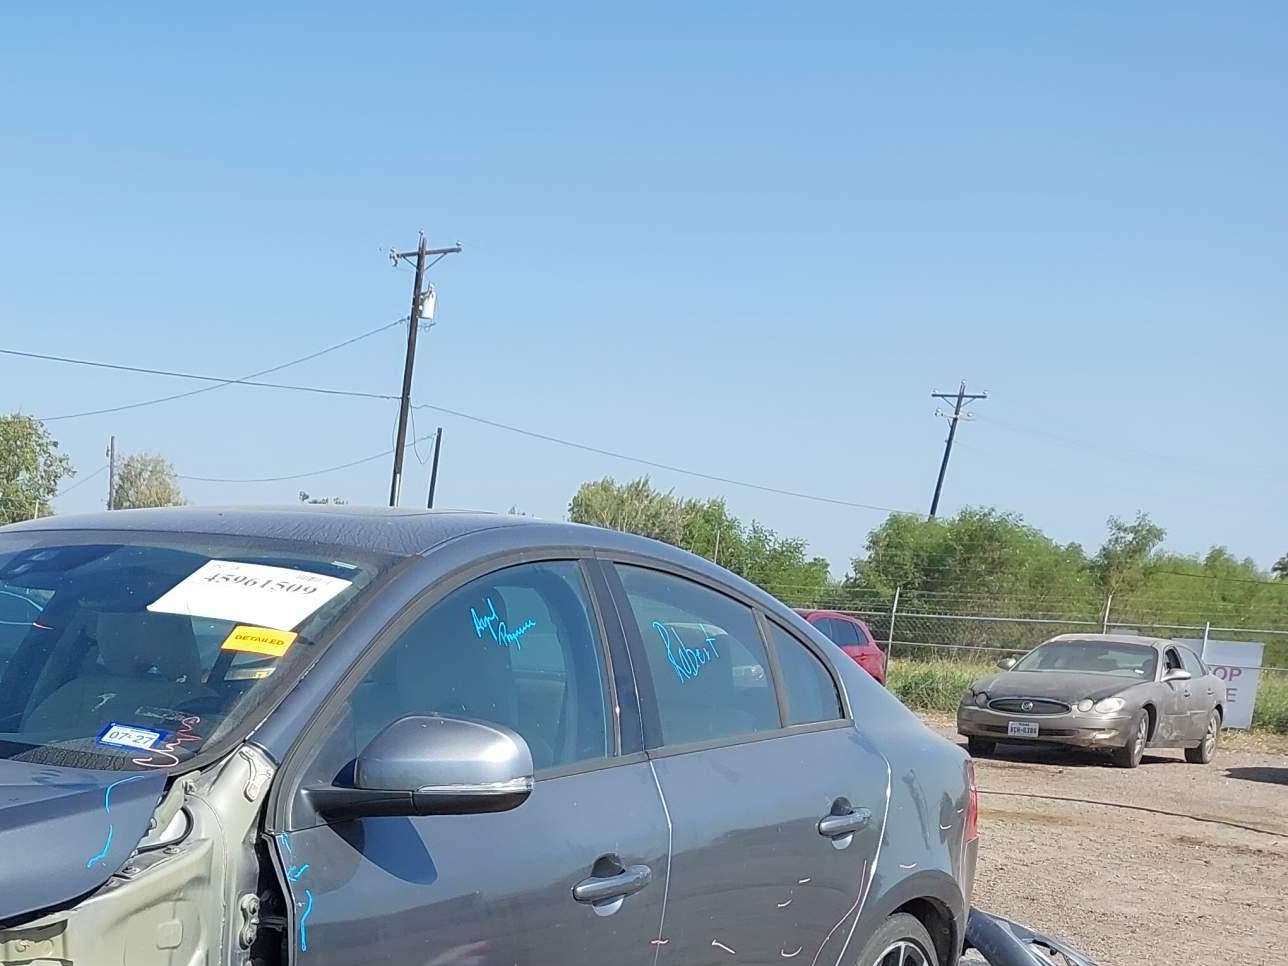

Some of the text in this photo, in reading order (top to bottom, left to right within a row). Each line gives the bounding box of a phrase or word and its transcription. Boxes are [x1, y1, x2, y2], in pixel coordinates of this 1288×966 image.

[203, 571, 318, 595] 45961509
[234, 634, 286, 646] DETAILED
[1208, 666, 1243, 681] OP
